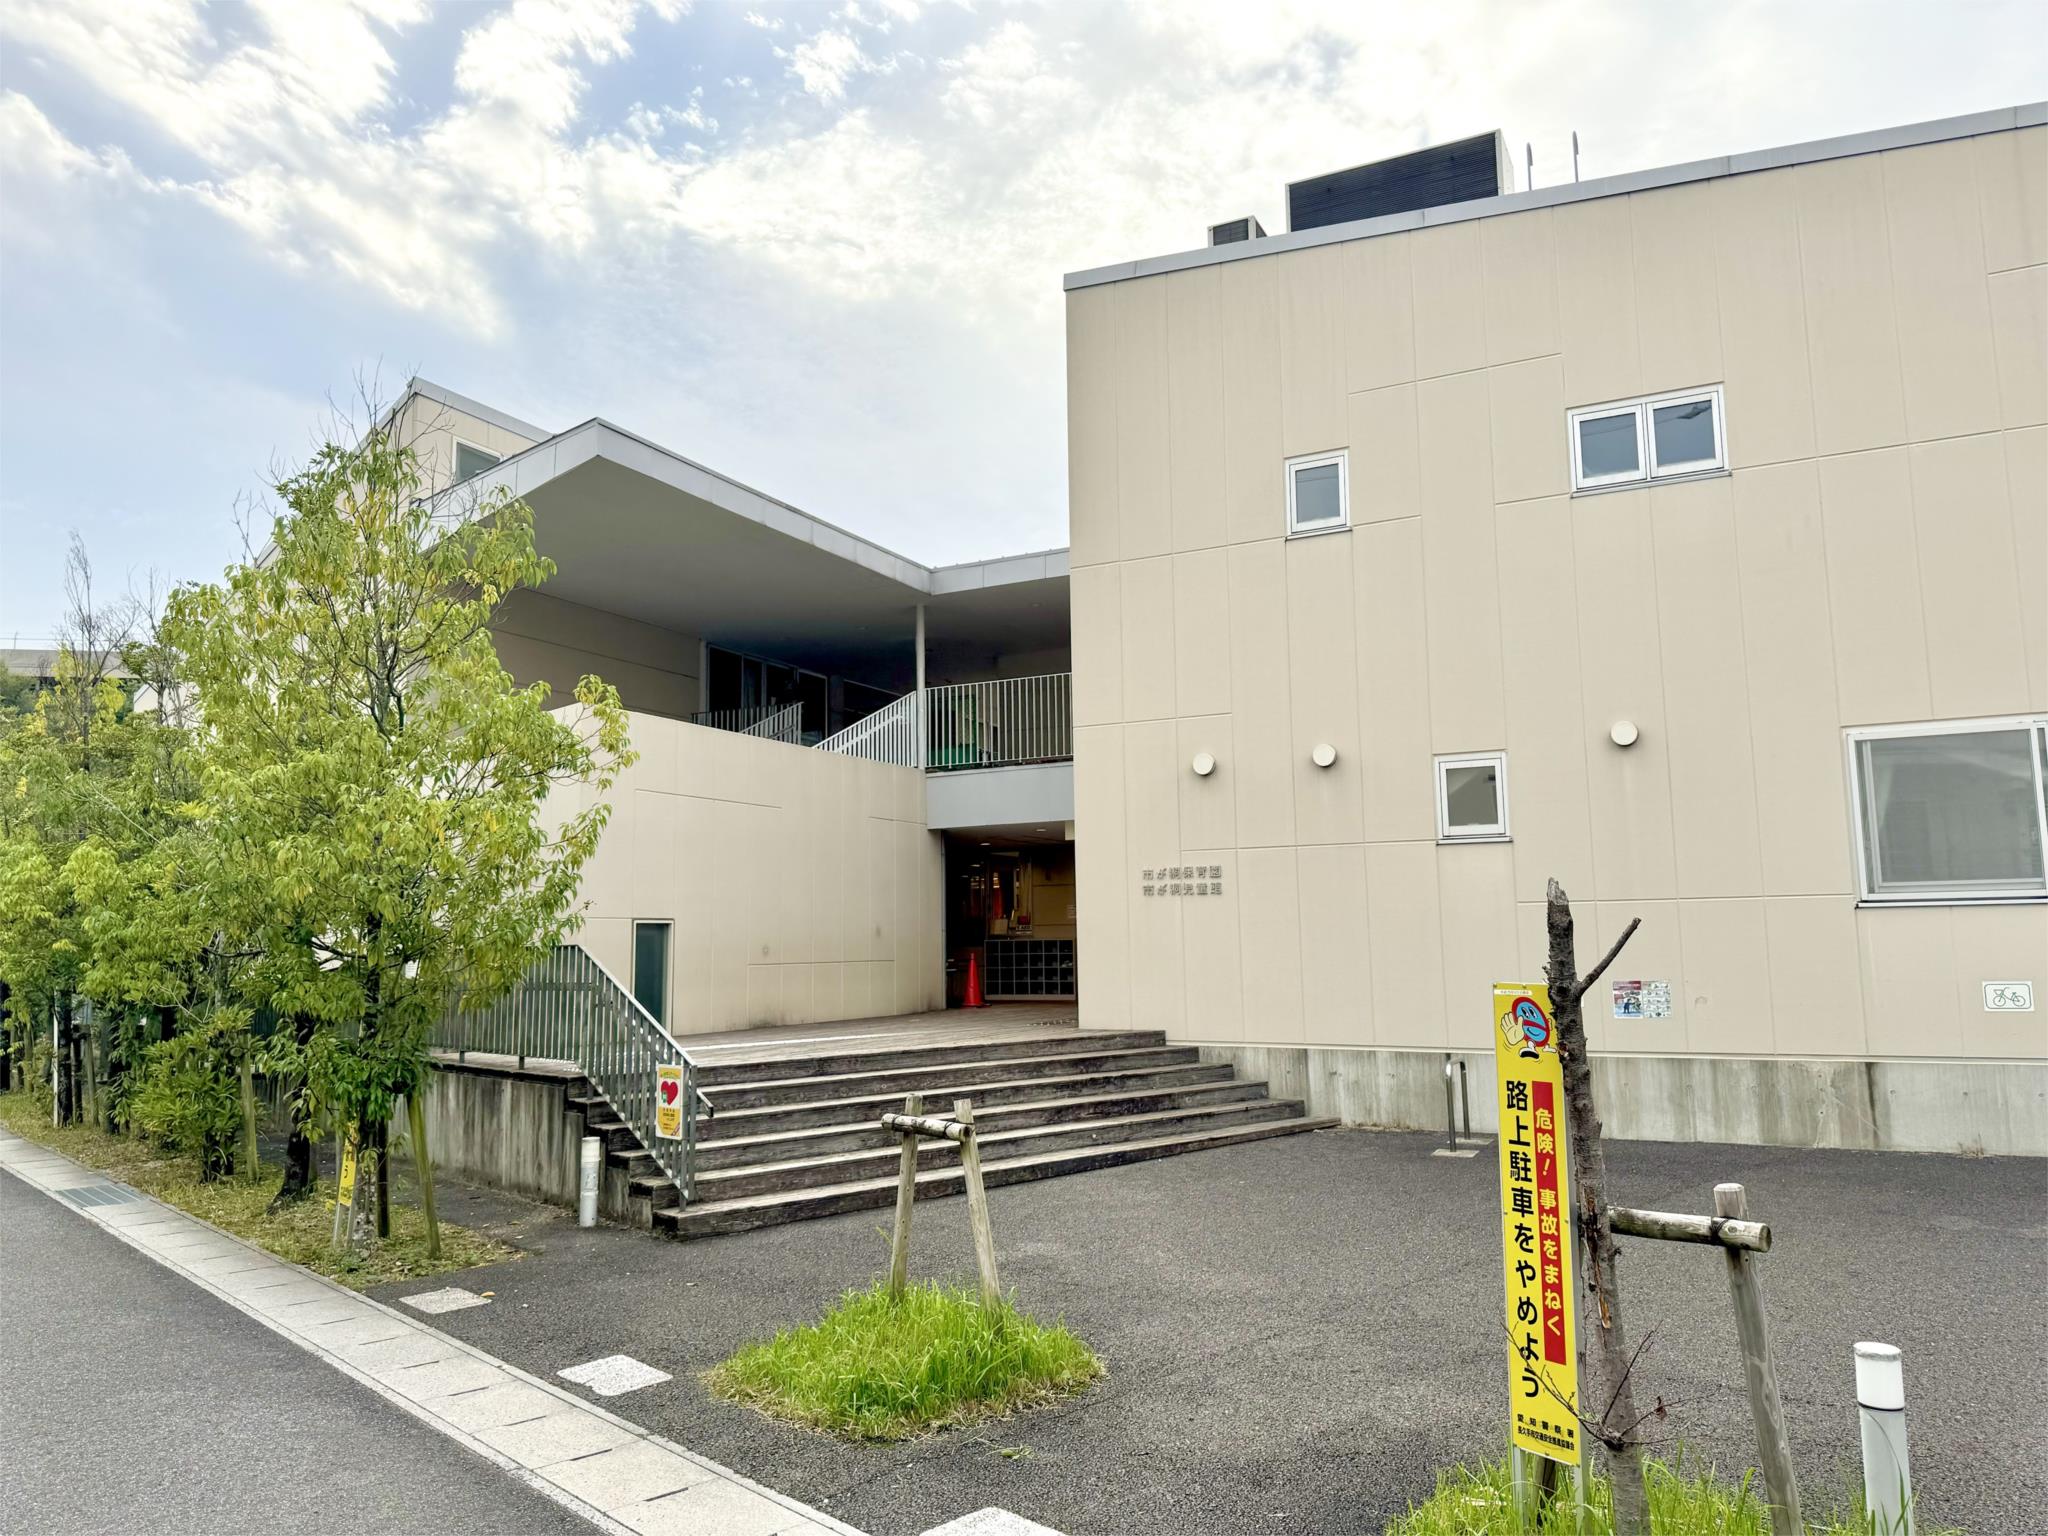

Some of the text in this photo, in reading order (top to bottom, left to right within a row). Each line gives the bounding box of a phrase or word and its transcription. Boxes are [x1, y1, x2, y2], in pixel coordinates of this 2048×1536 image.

[1506, 1080, 1539, 1398] 路上駐車をやめよう
